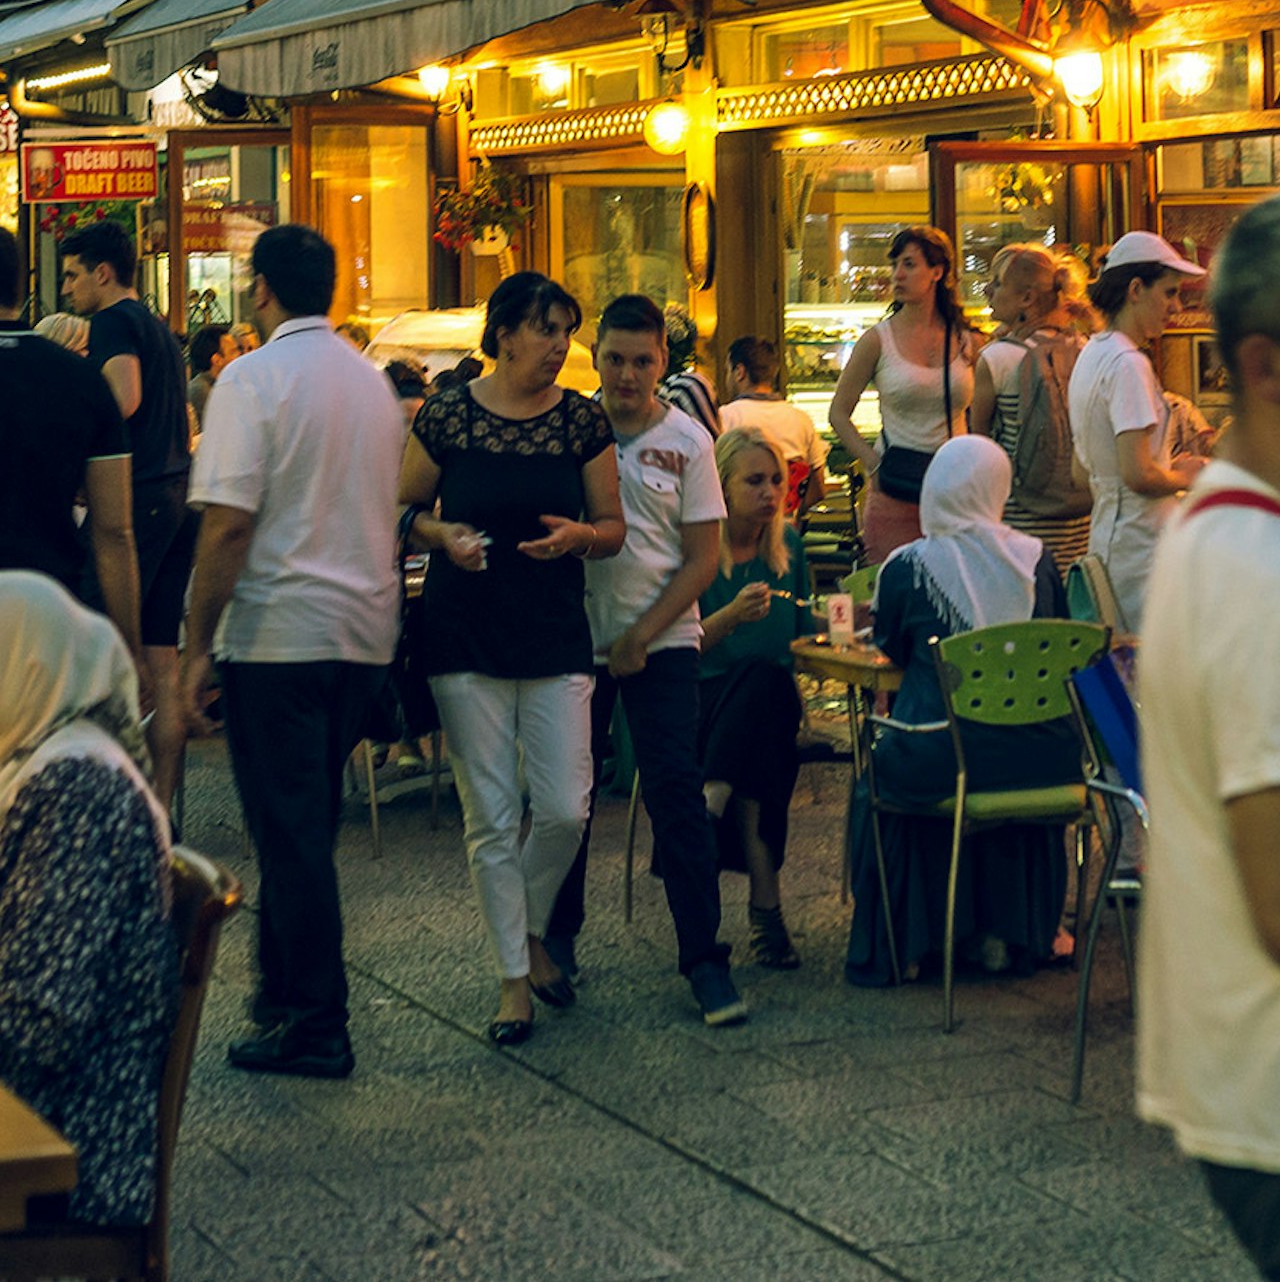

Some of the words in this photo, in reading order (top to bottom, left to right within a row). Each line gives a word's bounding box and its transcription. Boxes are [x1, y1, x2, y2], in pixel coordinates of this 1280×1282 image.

[63, 148, 120, 171] TOČENO
[121, 148, 154, 169] PIVO
[64, 172, 114, 195] DRAFT
[116, 171, 154, 193] BEER
